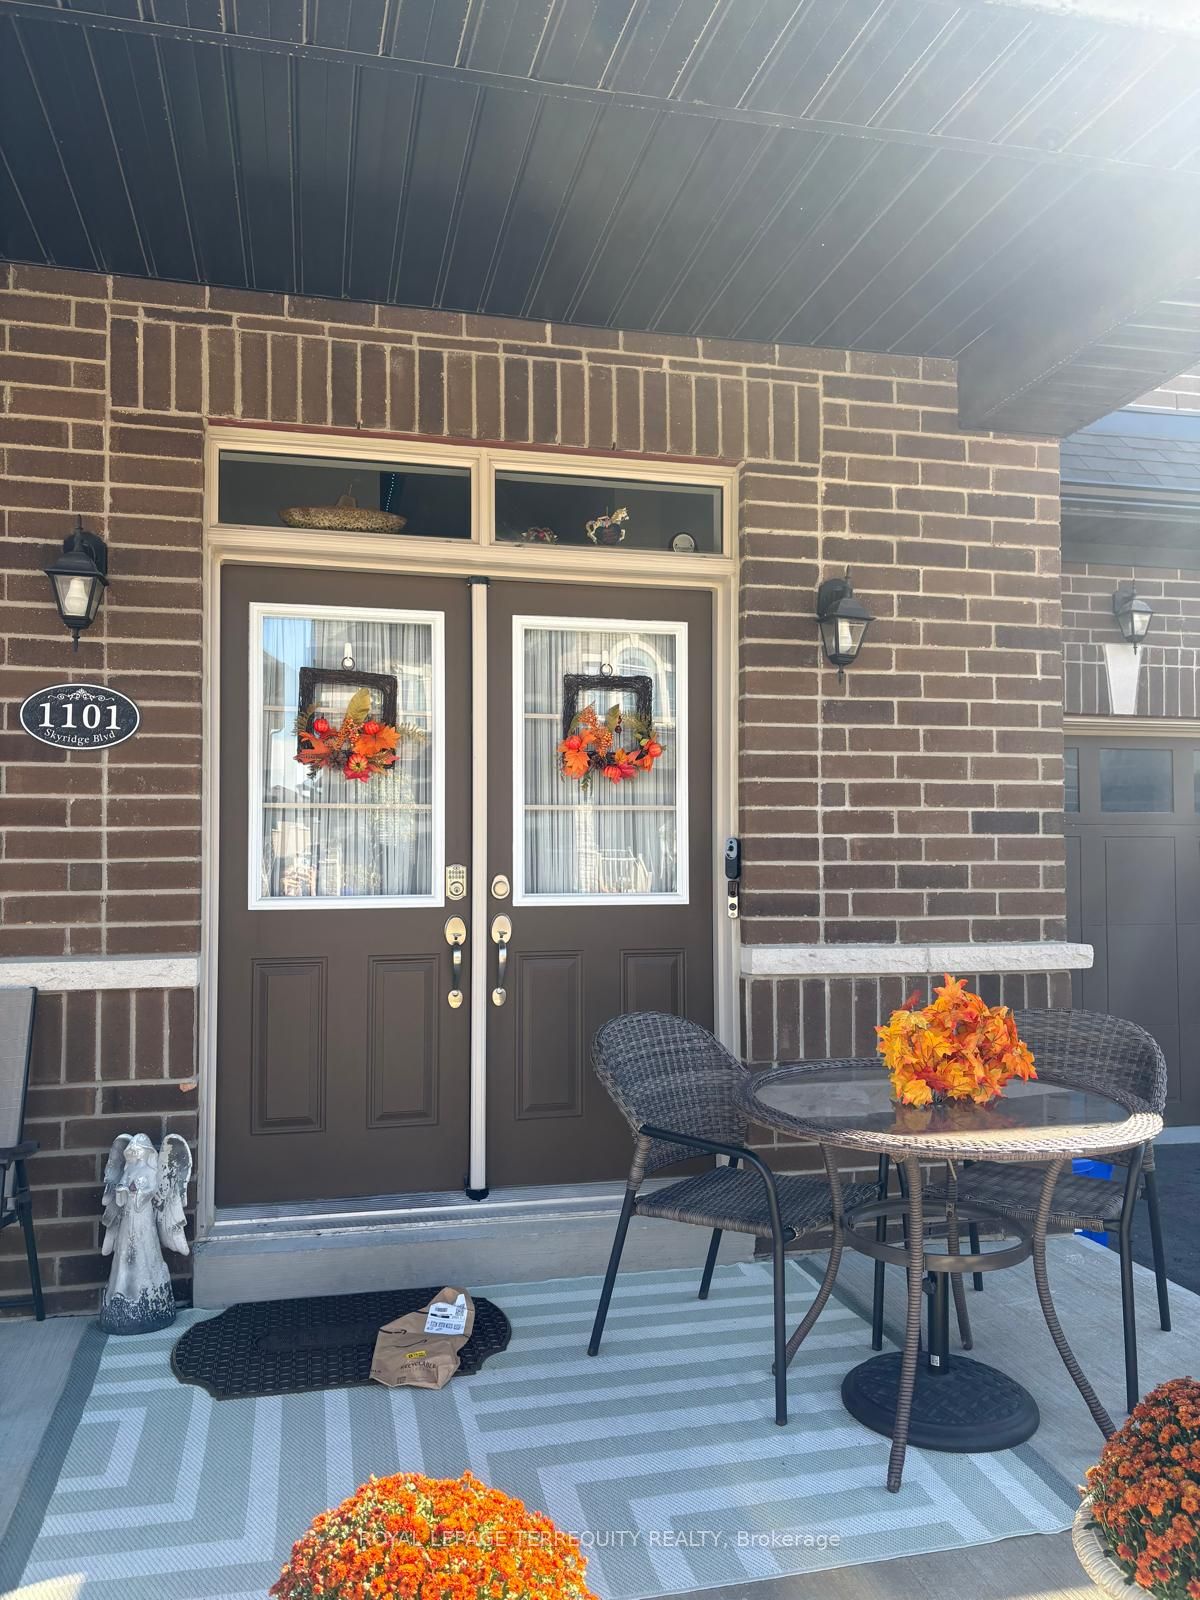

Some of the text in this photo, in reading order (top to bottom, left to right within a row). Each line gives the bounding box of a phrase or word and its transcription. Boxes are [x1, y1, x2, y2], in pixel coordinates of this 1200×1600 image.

[38, 702, 121, 730] 1101
[44, 728, 116, 746] Skyridge Blvd
